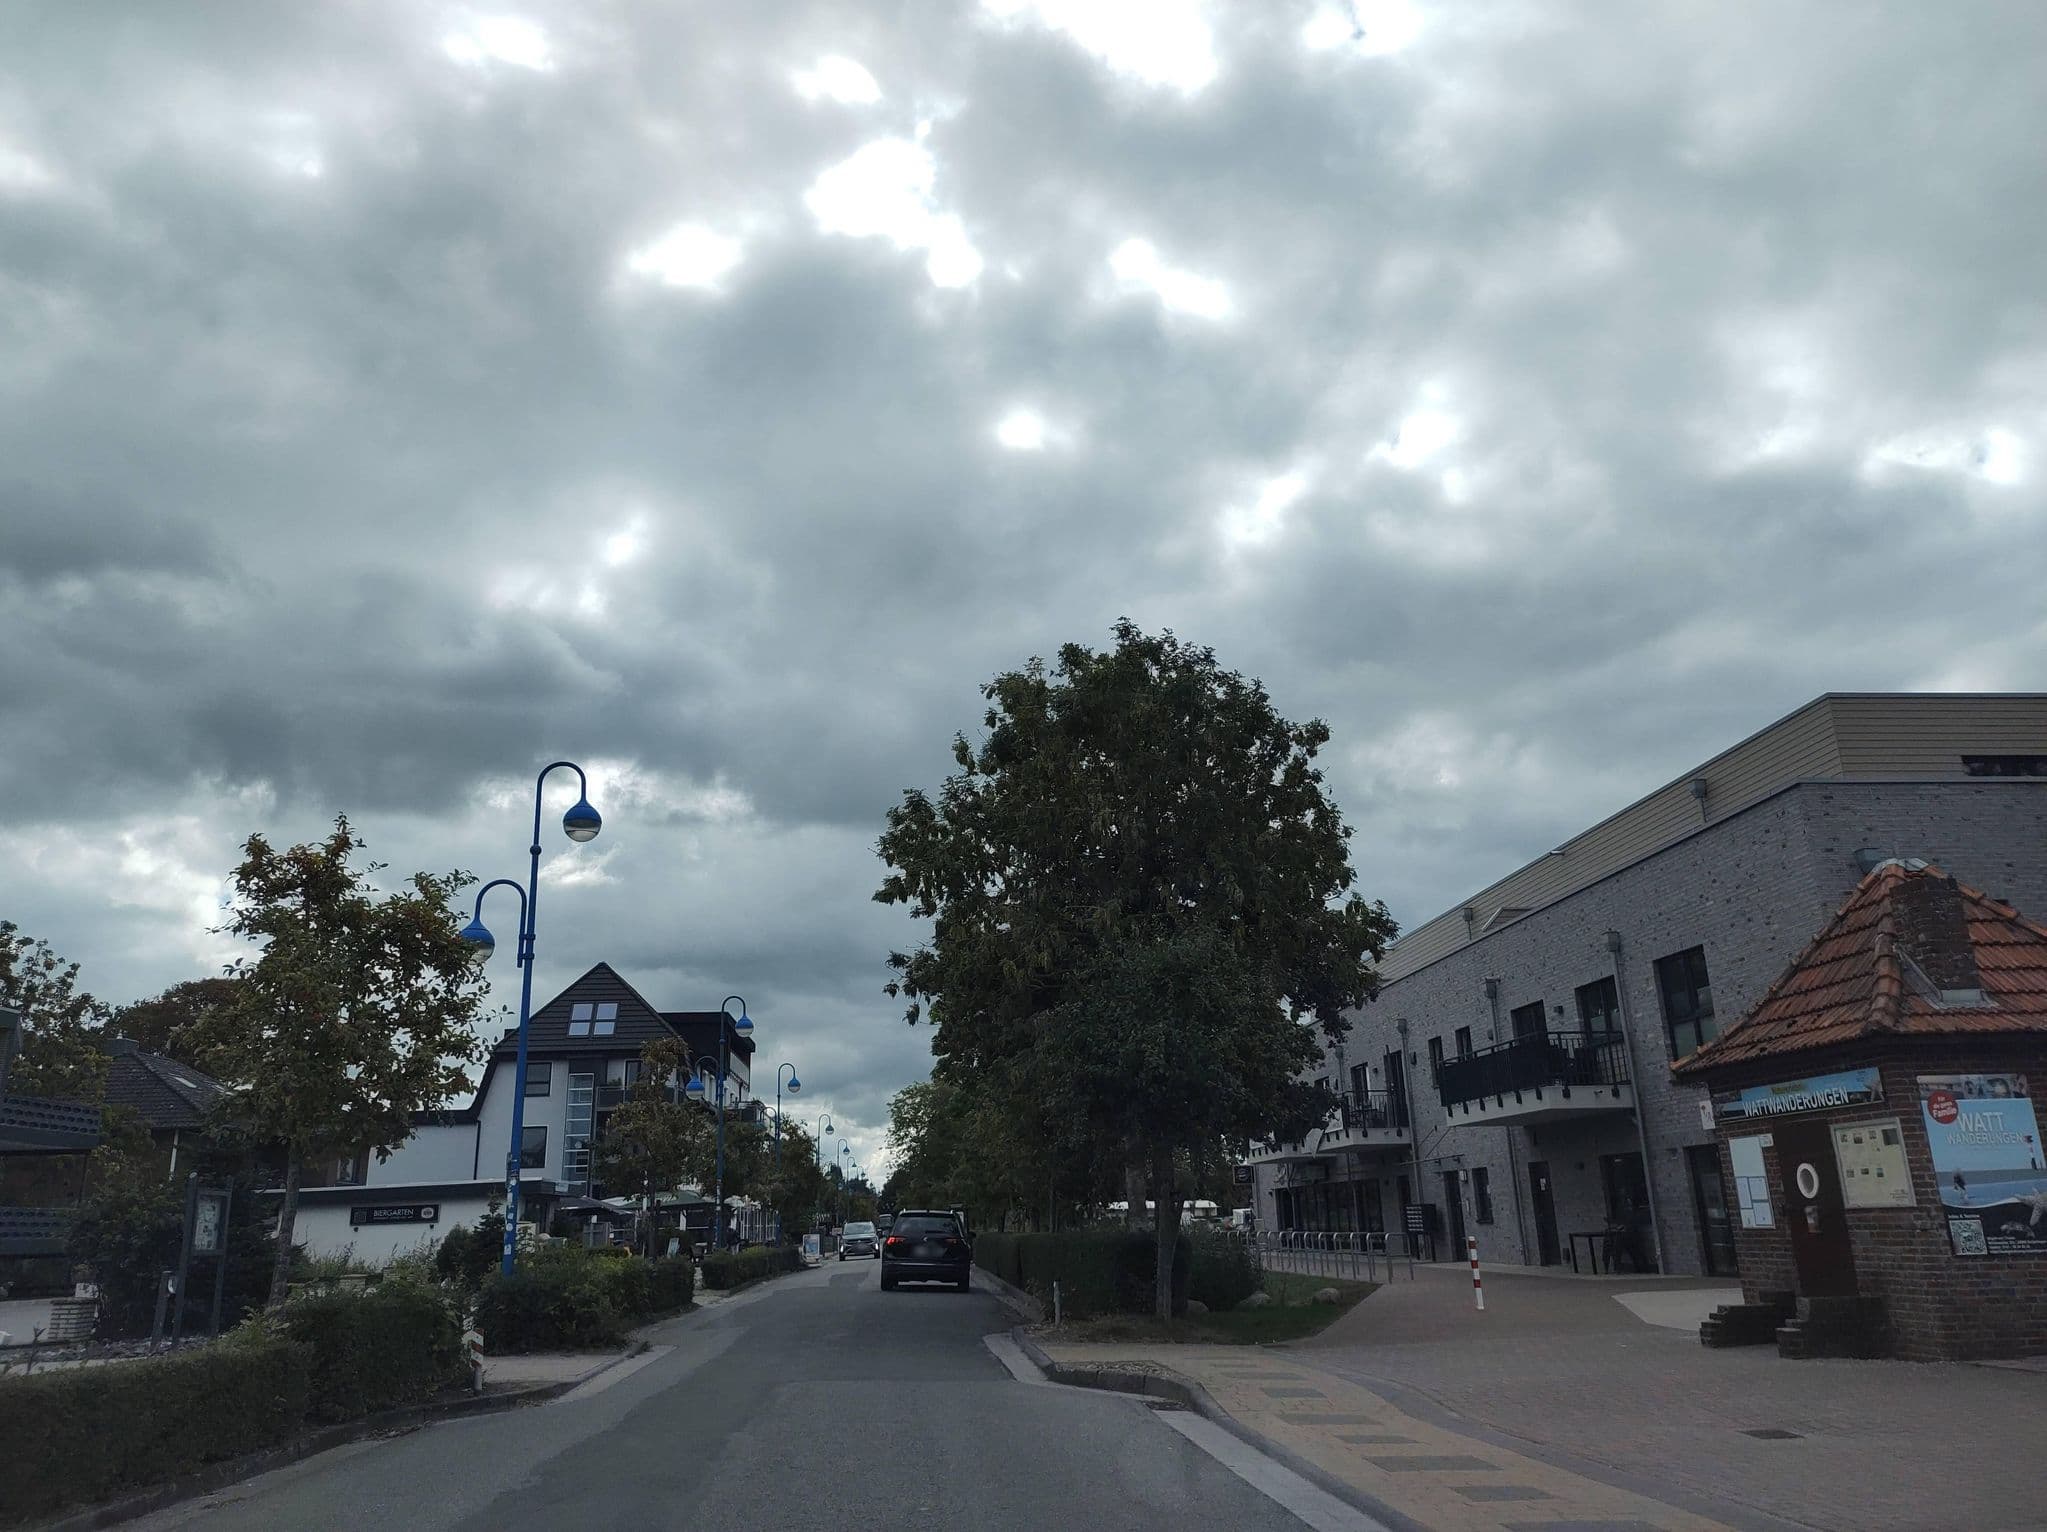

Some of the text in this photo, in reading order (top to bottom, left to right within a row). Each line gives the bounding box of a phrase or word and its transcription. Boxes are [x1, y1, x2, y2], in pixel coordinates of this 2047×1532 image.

[1743, 1087, 1850, 1117] WATTWANDERUNGEN
[1958, 1112, 2005, 1132] WATT
[1945, 1131, 2024, 1145] WANDERUNGEN
[373, 1208, 415, 1217] BIERGARTEN
